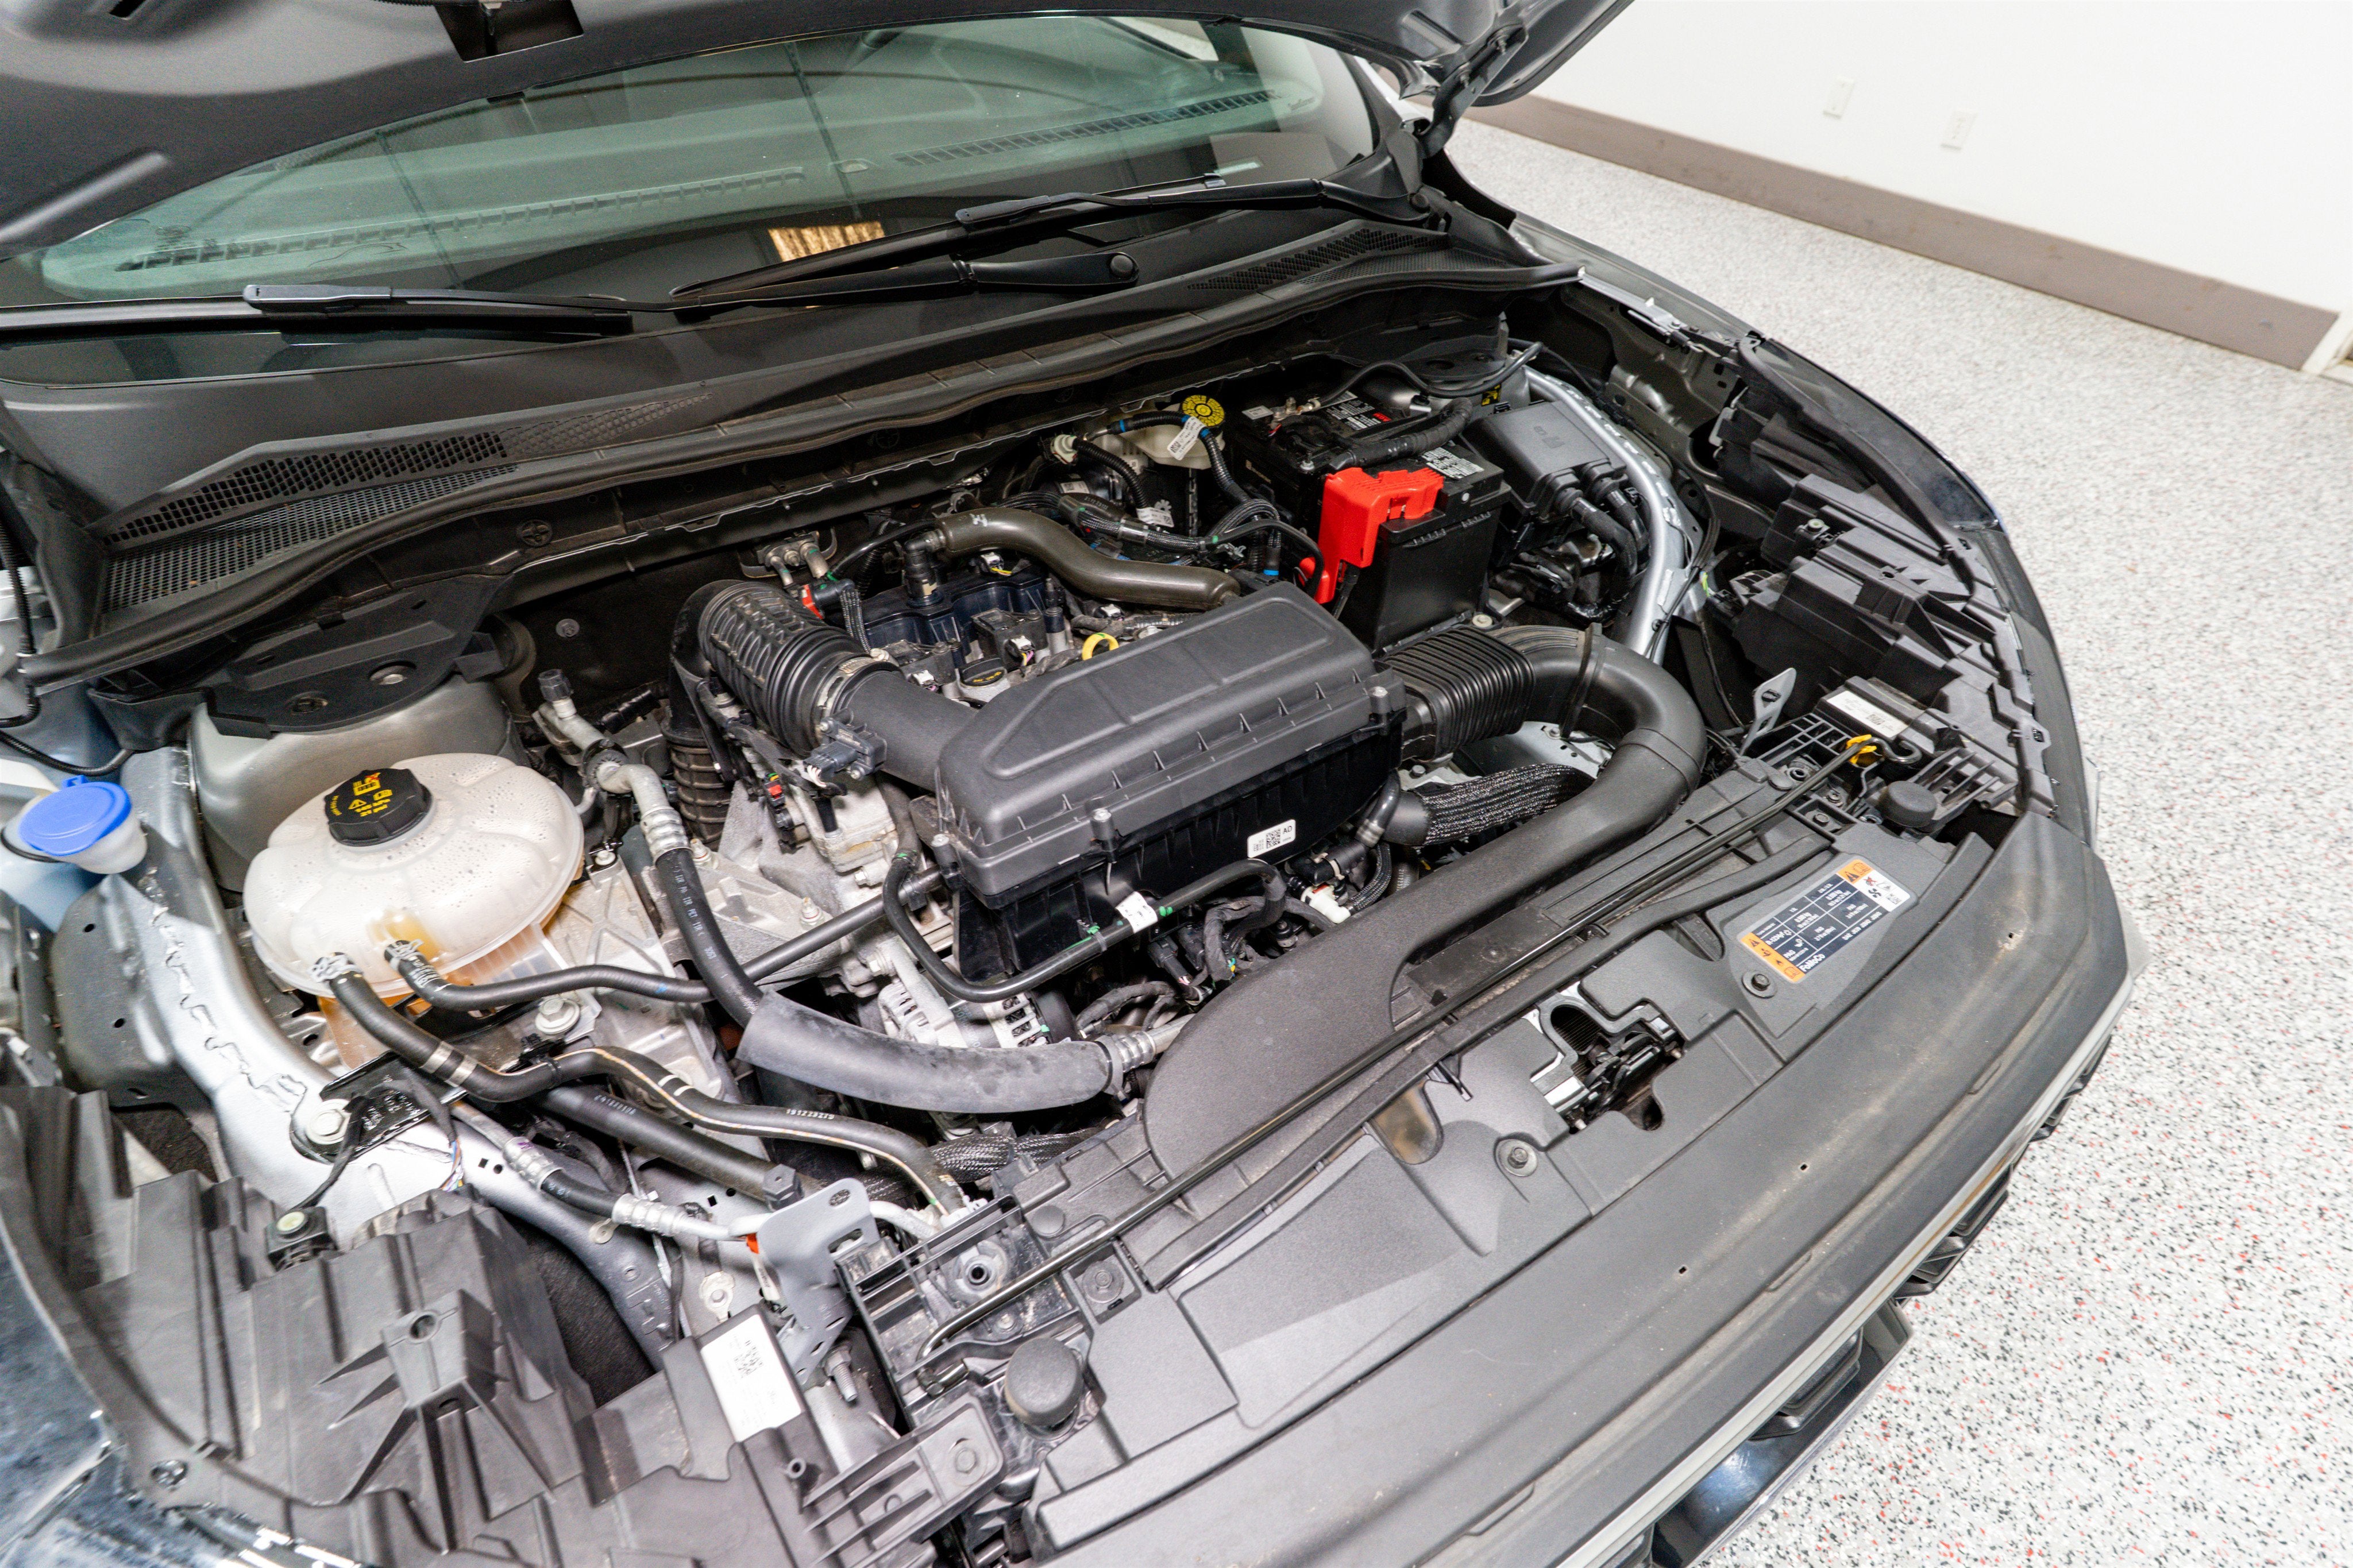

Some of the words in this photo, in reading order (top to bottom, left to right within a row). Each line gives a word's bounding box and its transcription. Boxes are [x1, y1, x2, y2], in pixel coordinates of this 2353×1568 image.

[1283, 825, 1293, 835] AD
[1783, 949, 1796, 959] PAG
[1799, 953, 1826, 972] FoMoCo
[1842, 933, 1853, 941] SAE
